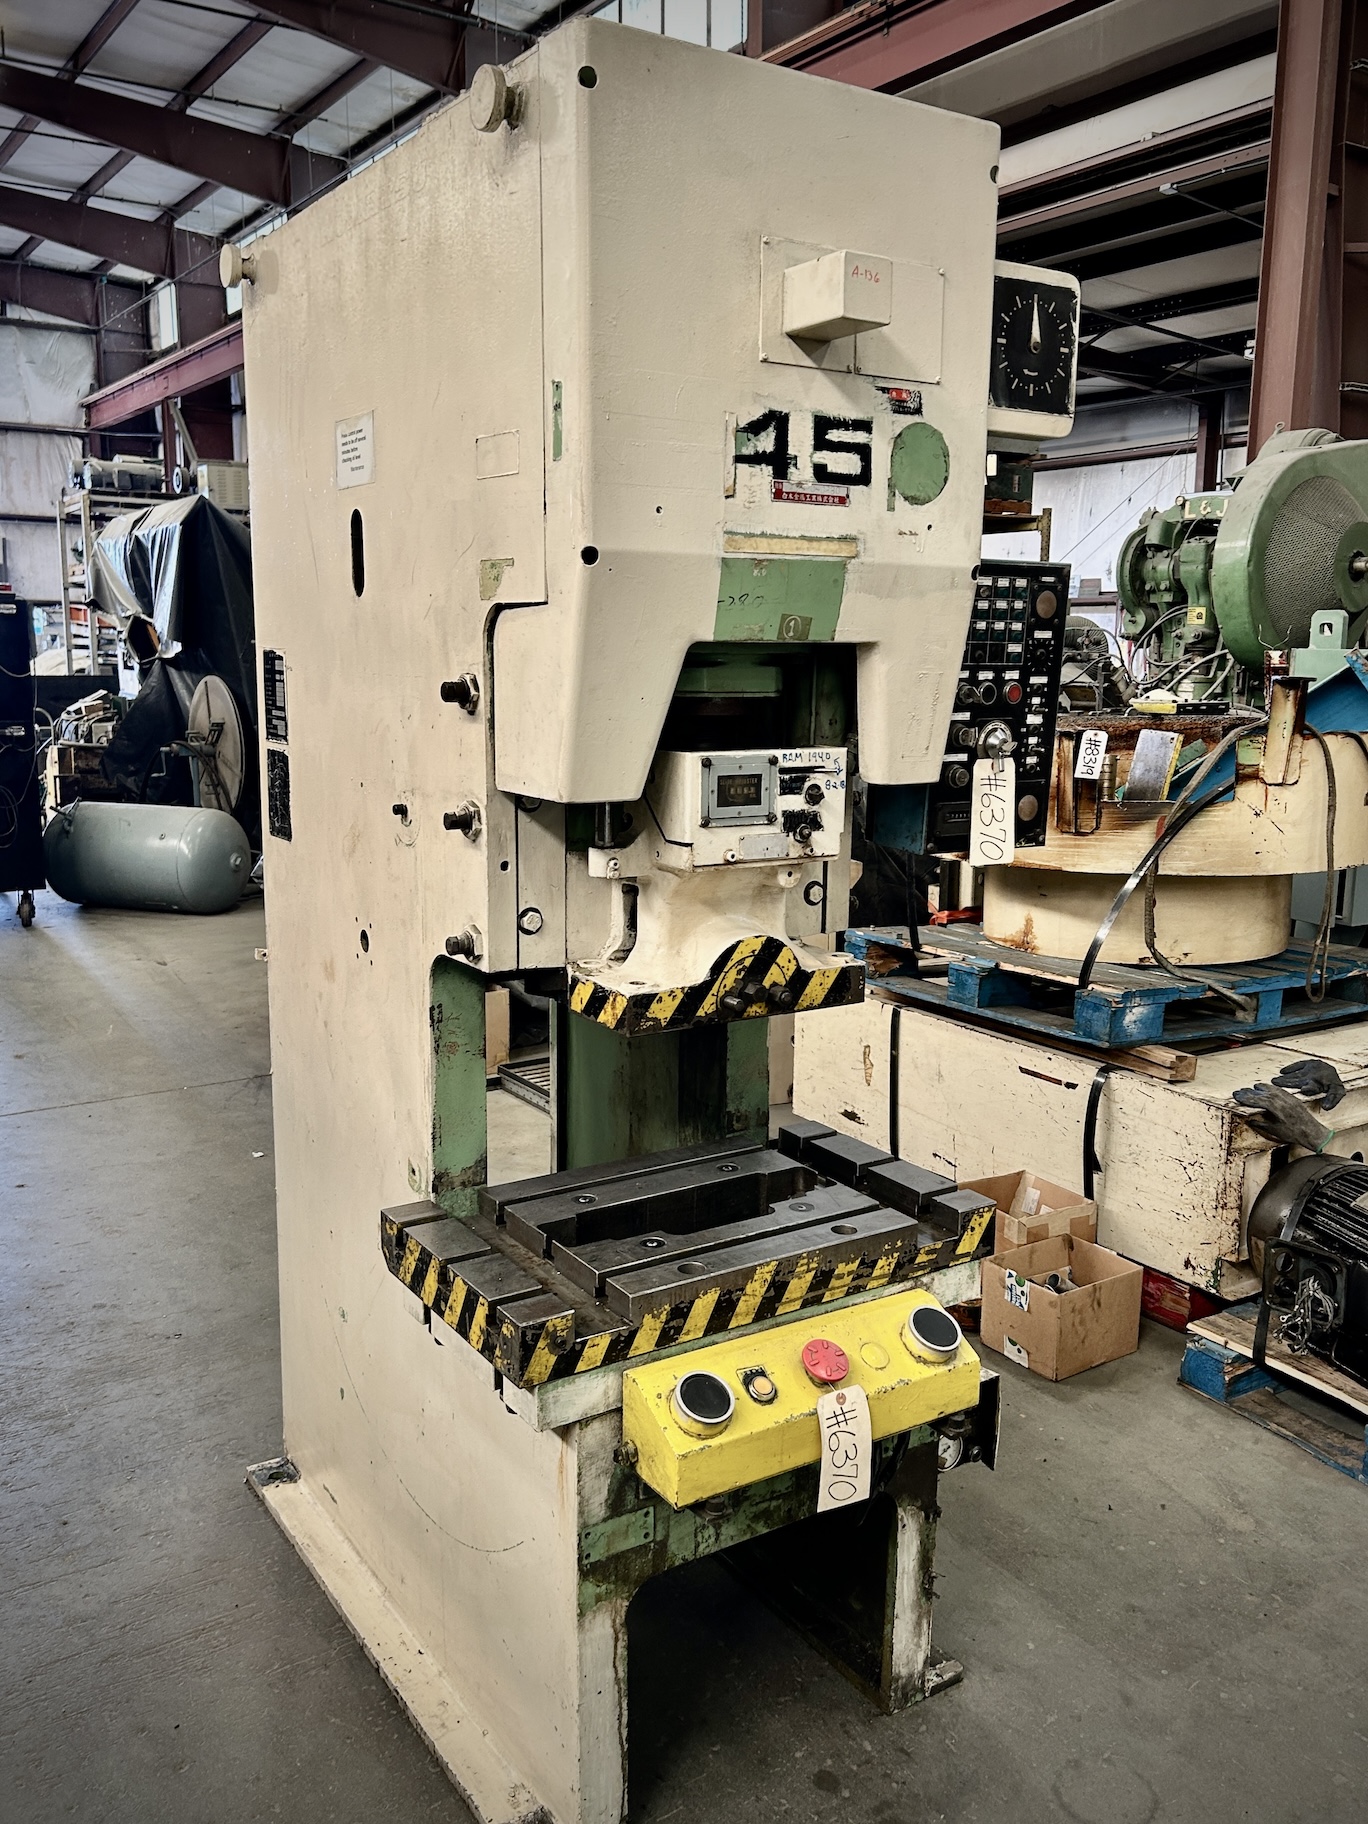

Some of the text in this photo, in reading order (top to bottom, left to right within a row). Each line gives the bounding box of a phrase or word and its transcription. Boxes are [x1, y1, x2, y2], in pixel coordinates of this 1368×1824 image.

[734, 409, 872, 487] 45
[1184, 500, 1196, 519] L
[1215, 499, 1229, 517] J
[1080, 737, 1102, 776] #8319
[979, 772, 1007, 861] #6370
[826, 1406, 859, 1501] #6370
